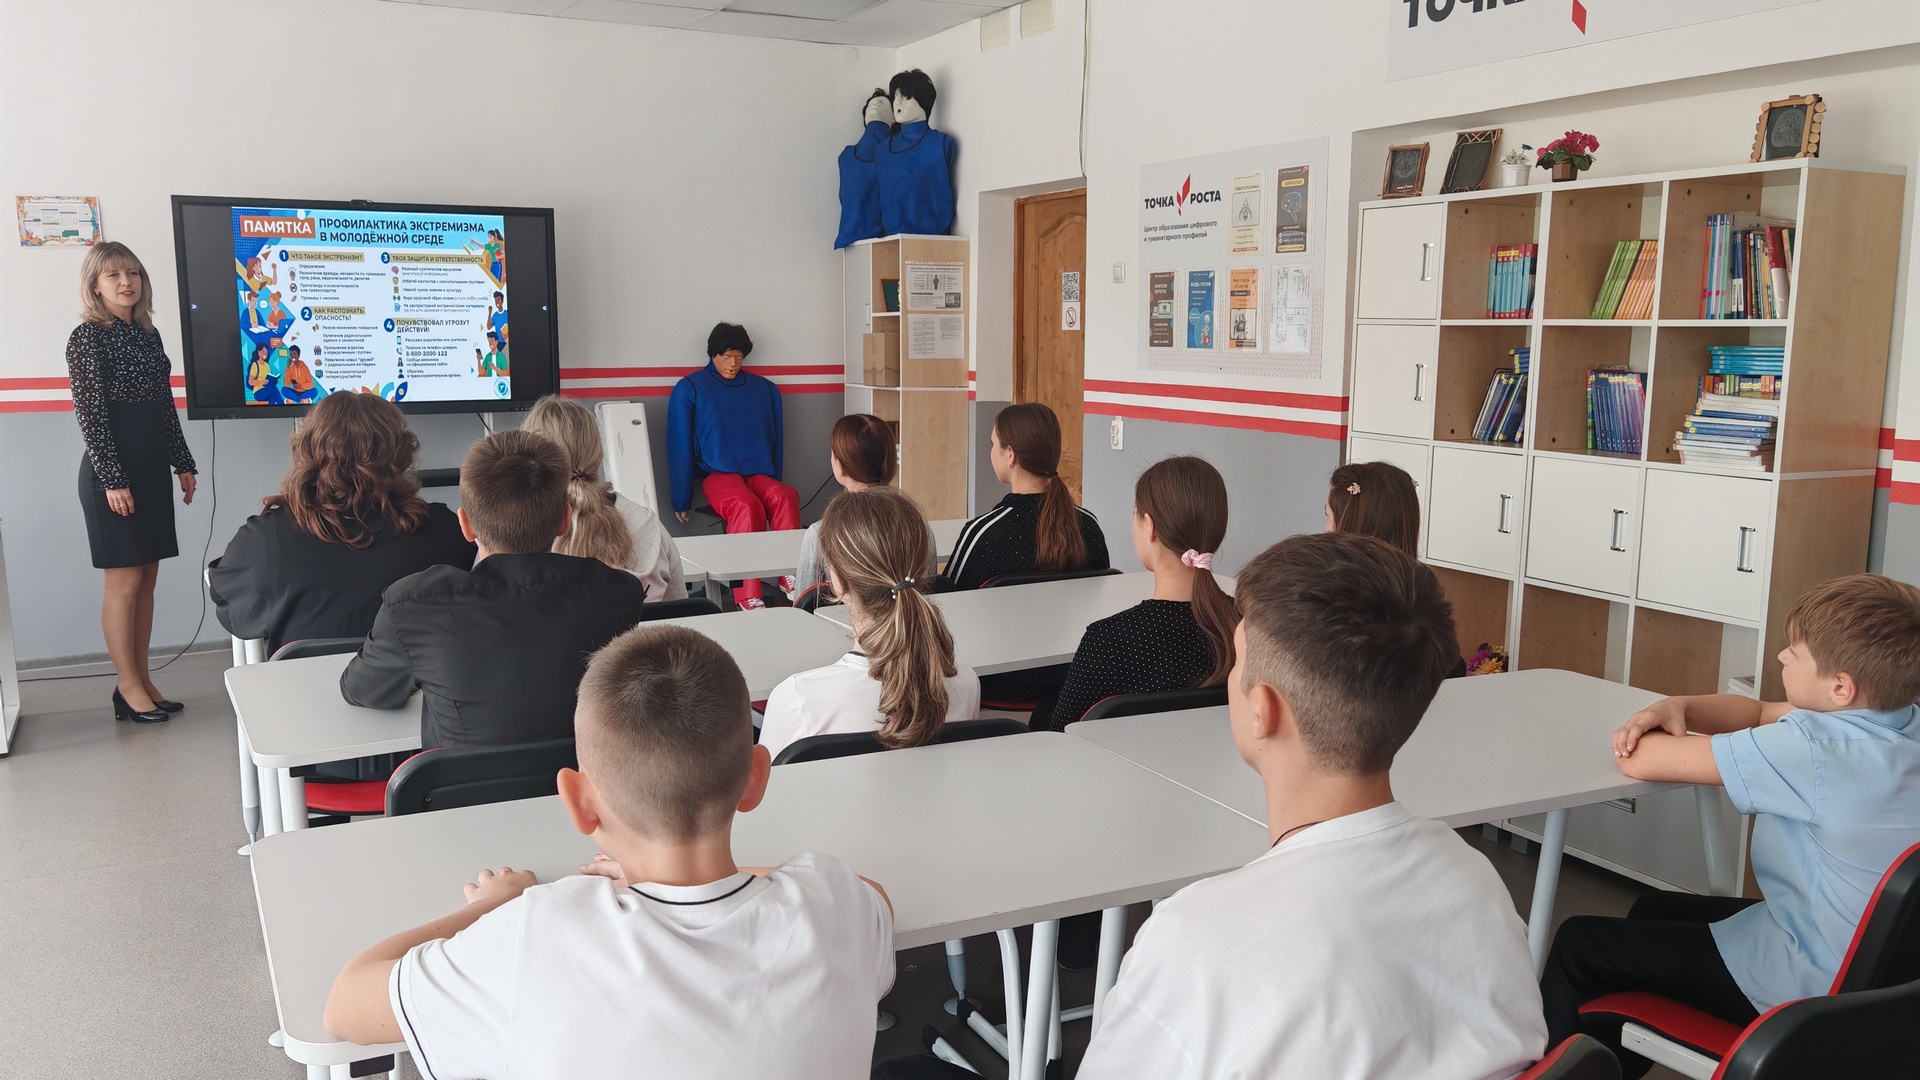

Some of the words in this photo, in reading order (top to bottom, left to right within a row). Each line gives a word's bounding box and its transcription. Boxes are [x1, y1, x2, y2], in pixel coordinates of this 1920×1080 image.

[1144, 196, 1174, 209] ТОЧКА
[1190, 190, 1221, 204] РОСТА
[243, 220, 312, 235] ПАМЯТКА
[319, 218, 407, 231] ПРОФИЛАКТИКА
[409, 220, 485, 233] ЭКСТРЕМИЗМА
[1144, 224, 1158, 233] Центр
[1158, 223, 1189, 232] образования
[1190, 220, 1217, 229] цифрового
[320, 232, 327, 242] В
[330, 231, 408, 244] МОЛОДЁЖНОЙ
[412, 234, 444, 245] СРЕДЕ
[1148, 233, 1182, 243] гуманитарного
[1182, 231, 1208, 240] профилей
[303, 310, 309, 318] 2
[386, 321, 393, 329] 4
